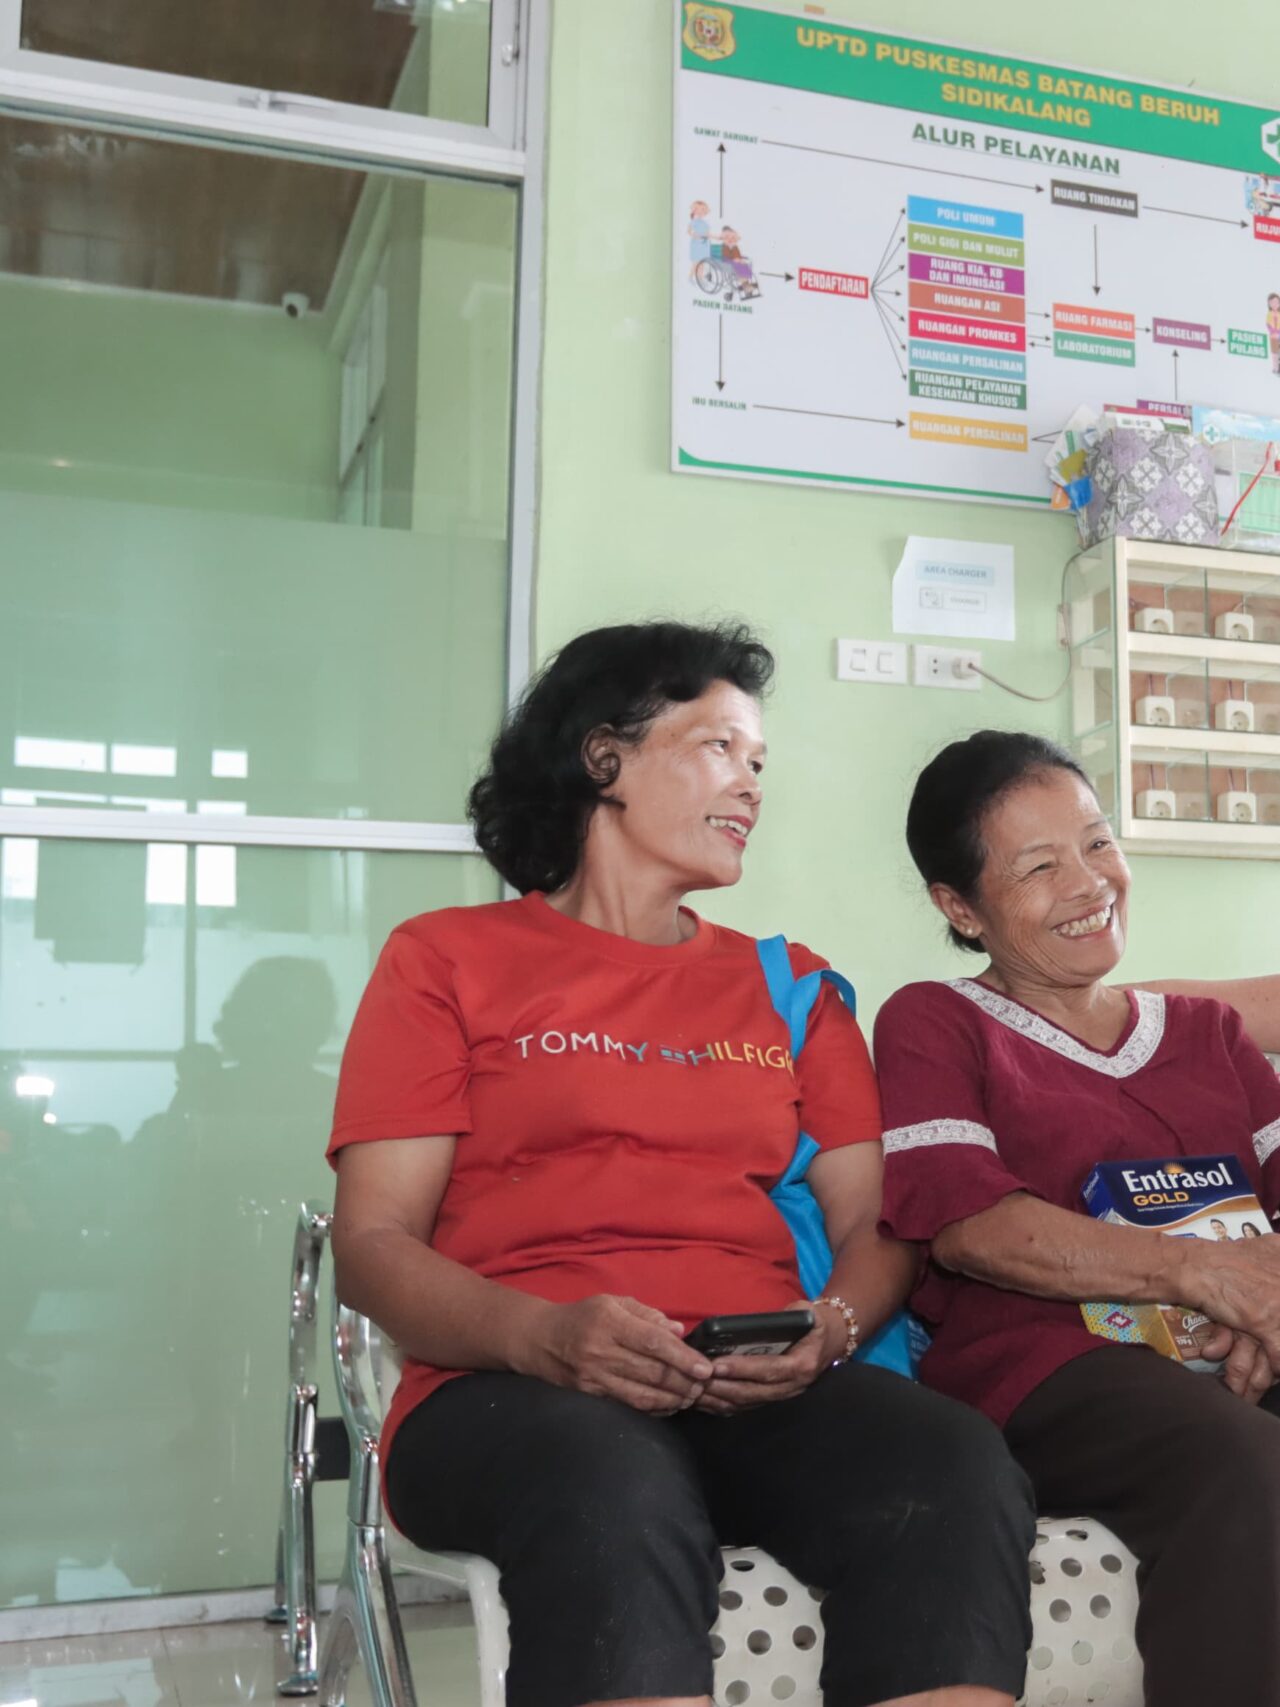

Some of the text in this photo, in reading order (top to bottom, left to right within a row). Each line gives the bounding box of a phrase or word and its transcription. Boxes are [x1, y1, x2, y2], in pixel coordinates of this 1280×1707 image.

[796, 26, 1220, 126] UPTD PUSKESMAS BATANG BERUH
[941, 82, 1092, 128] SIDIKALANG
[912, 123, 1121, 175] ALUR PELAYANAN
[1054, 186, 1136, 211] RUANG TINDAKAN
[937, 207, 995, 227] POLI UMUM
[913, 232, 1019, 259] POLI GIGI DAN MULUT
[929, 269, 1005, 291] DAN IMUNISASI
[930, 258, 1003, 279] RUANG KIA, KB
[801, 271, 866, 295] PENDAFTARAN
[934, 292, 1001, 313] RUANGAN ASI
[918, 319, 1017, 344] RUANGAN PROMKES
[1055, 310, 1133, 332] RUANG FARMASI
[1156, 325, 1208, 343] KONSELING
[1232, 331, 1264, 344] PASIEN
[911, 347, 1023, 373] RUANGAN PERSALINAN
[1057, 339, 1132, 360] LABORATORIUM
[1231, 342, 1265, 357] PULANG
[914, 371, 1021, 396] RUANGAN PELAYANAN
[918, 385, 1018, 408] KESEHATAN KHUSUS
[912, 420, 961, 436] RUANGAN
[514, 1030, 648, 1063] TOMMY
[1120, 1162, 1234, 1193] Entrasol
[1132, 1191, 1190, 1207] GOLD
